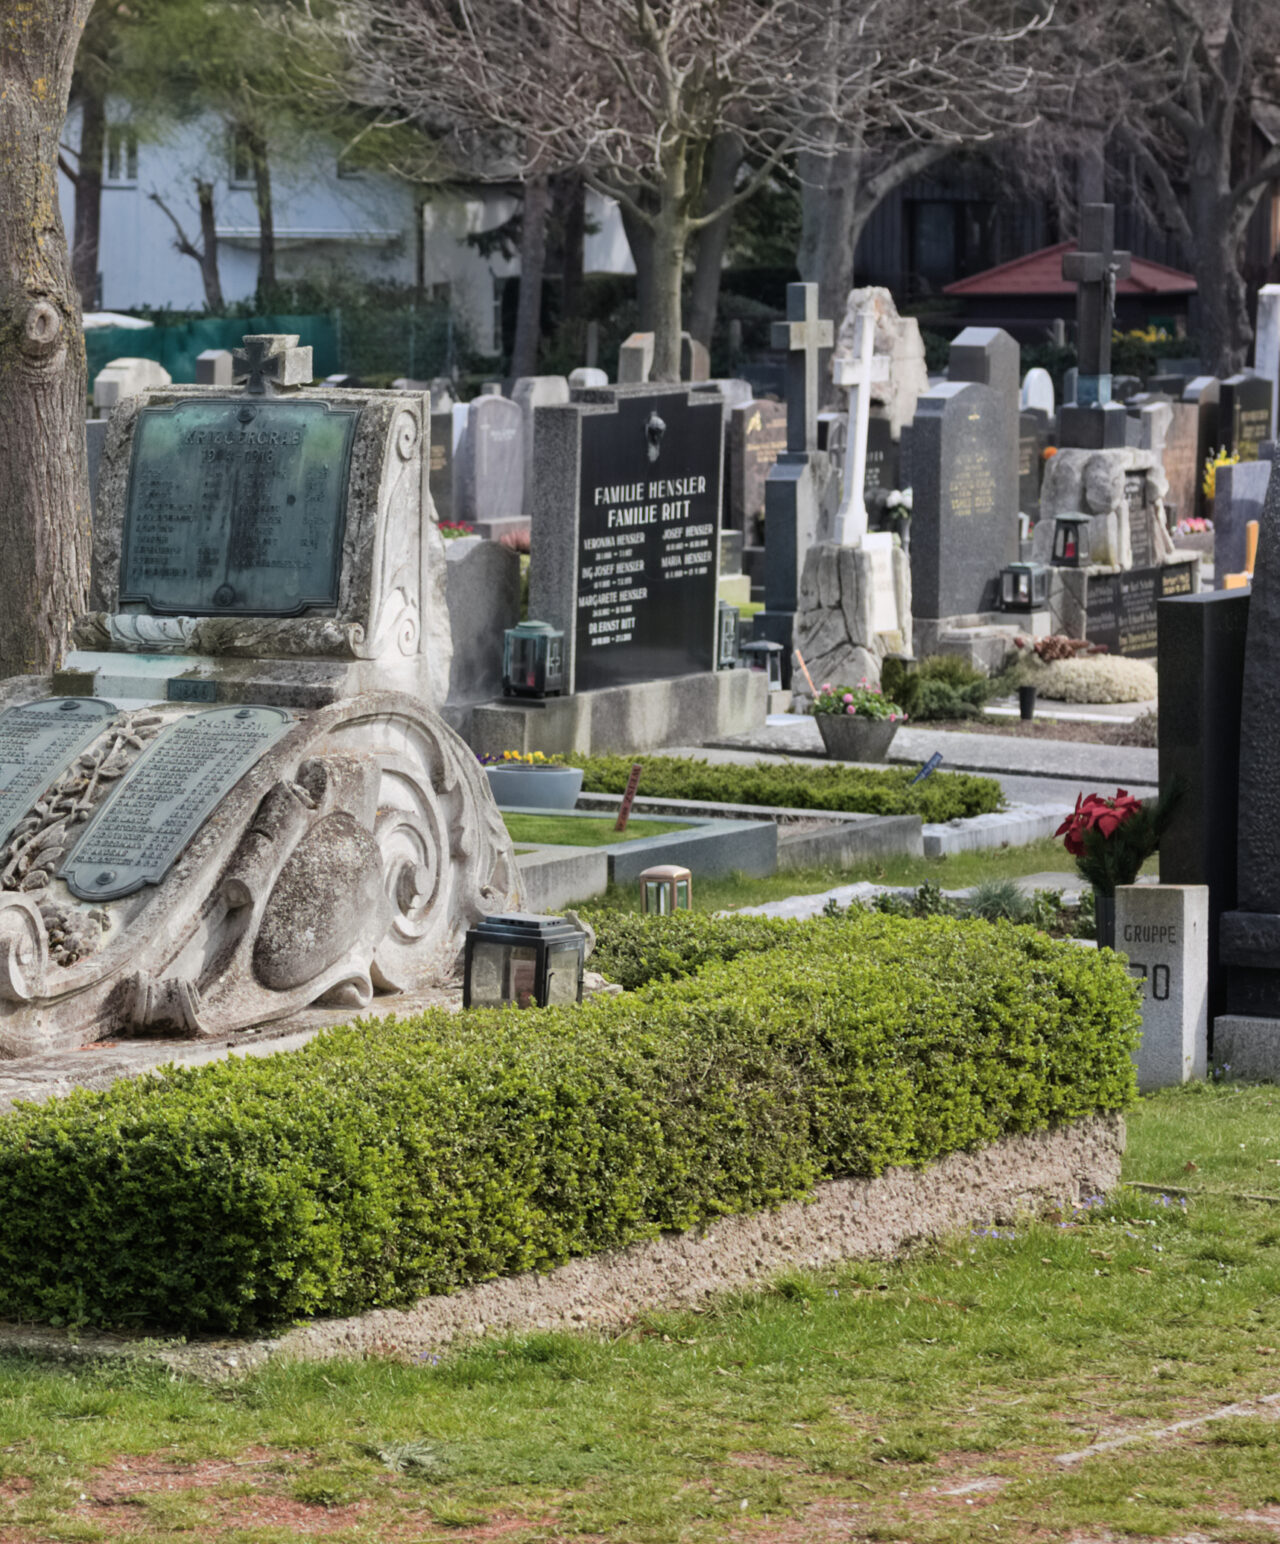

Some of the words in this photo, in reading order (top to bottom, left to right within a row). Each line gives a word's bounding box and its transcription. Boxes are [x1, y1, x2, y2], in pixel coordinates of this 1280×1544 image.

[594, 482, 645, 506] FAMILIE
[648, 475, 706, 499] HENSLER
[607, 504, 658, 528] FAMILIE
[662, 500, 691, 521] RITT
[583, 535, 616, 550] VERONIKA
[616, 531, 645, 546] HENSLER
[662, 526, 684, 540] JOSEF
[685, 523, 713, 537] HENSLER
[616, 559, 645, 574] HENSLER
[684, 550, 713, 565] HENSLER
[579, 591, 618, 607] MARGARETE
[619, 587, 648, 602] HENSLER
[1124, 924, 1177, 945] GRUPPE
